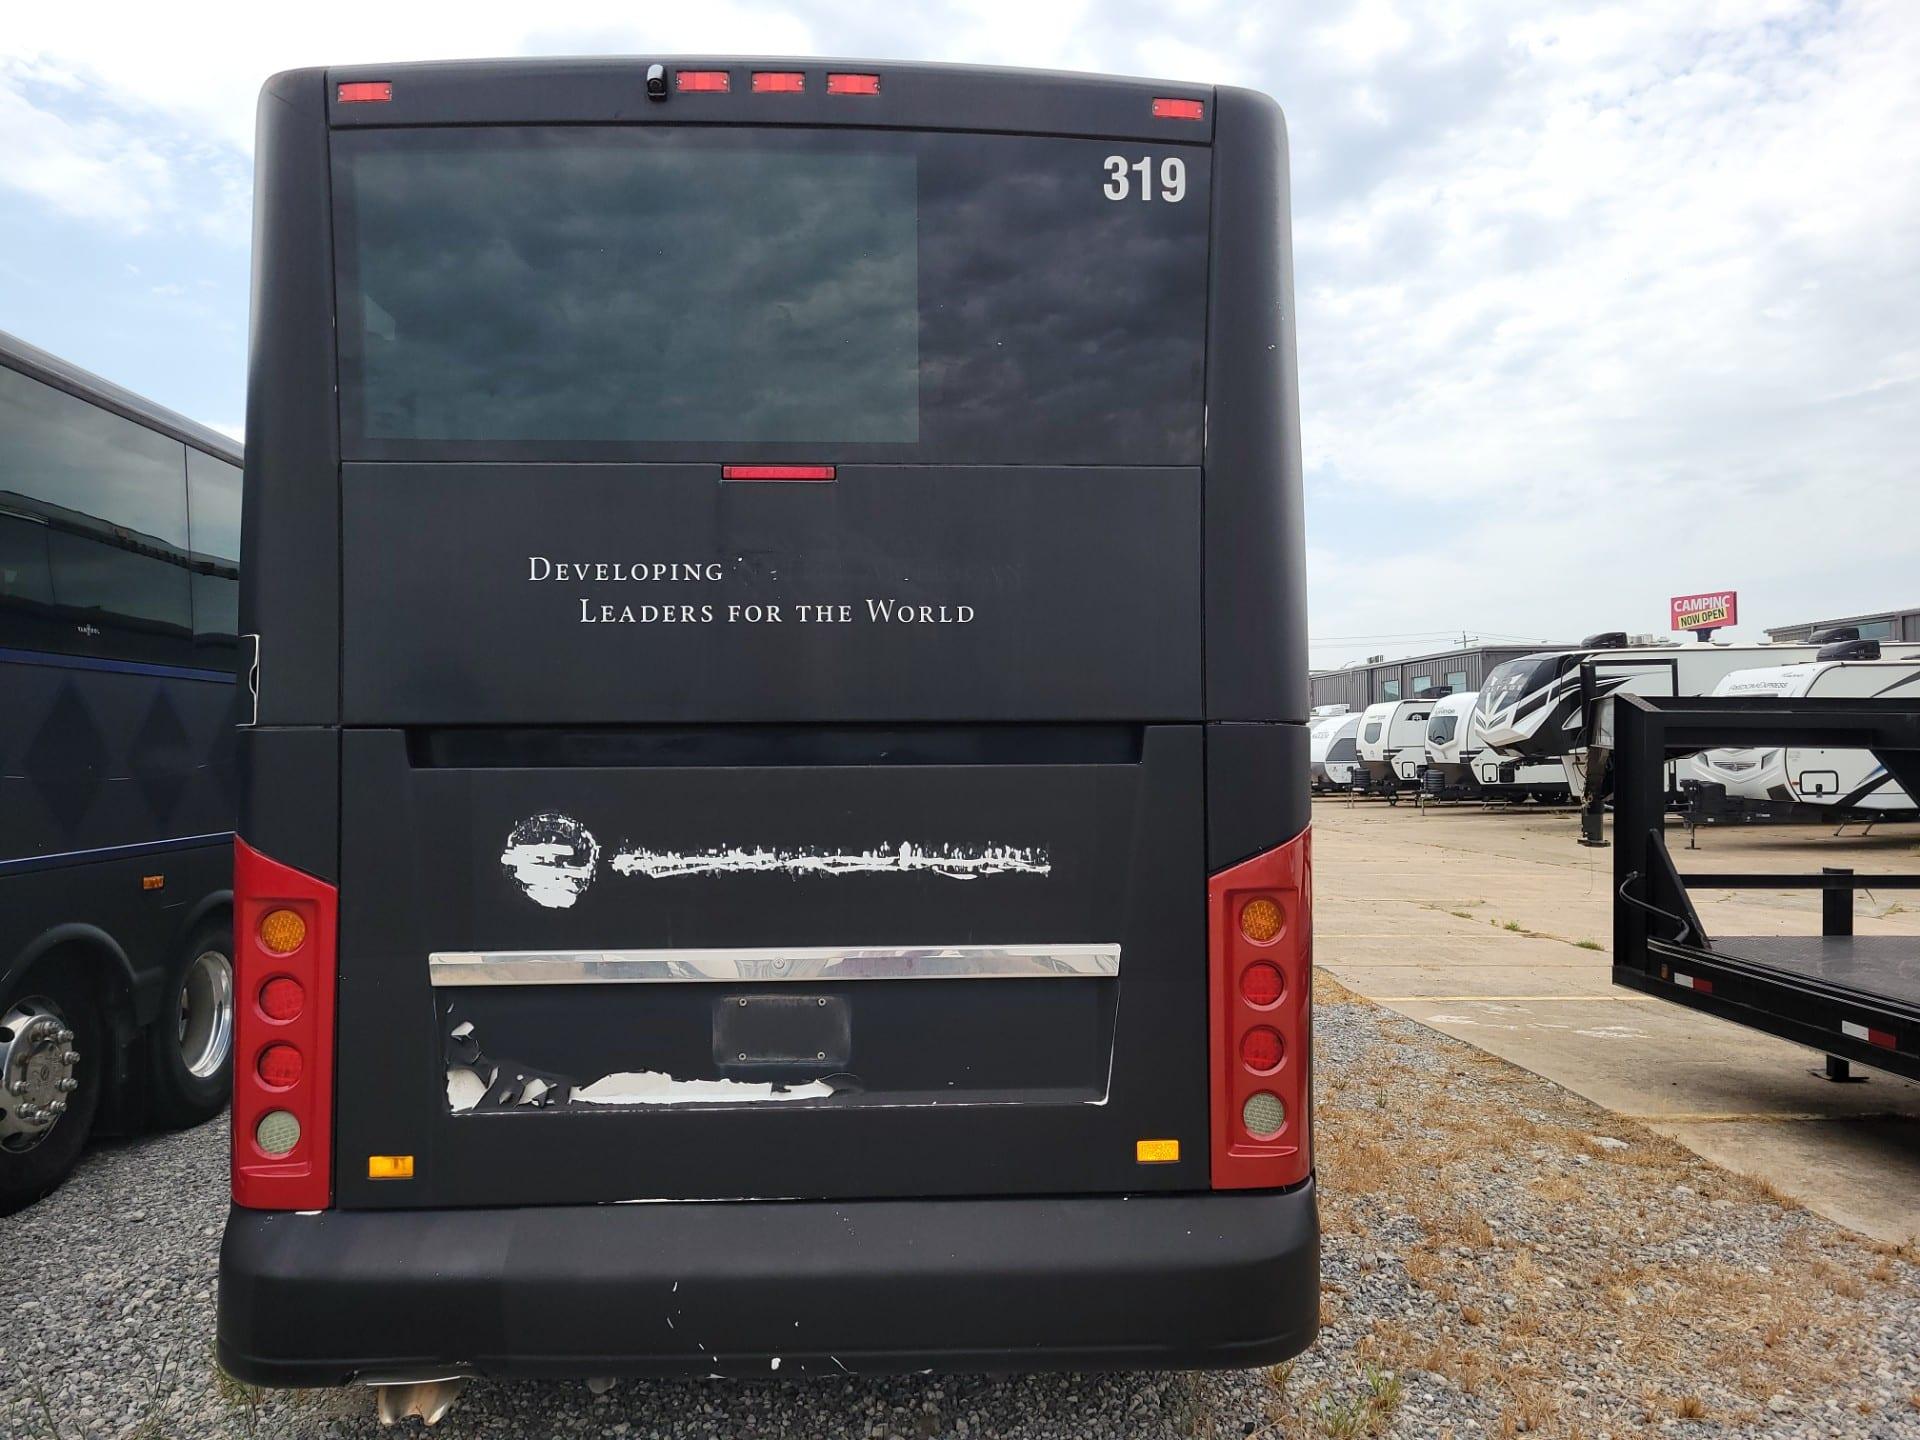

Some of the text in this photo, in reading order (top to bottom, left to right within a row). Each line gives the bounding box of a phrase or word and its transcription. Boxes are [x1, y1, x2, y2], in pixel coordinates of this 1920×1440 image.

[1103, 155, 1186, 203] 319
[528, 556, 723, 582] DEVELOPING
[579, 598, 975, 623] LEADERS FOR THE WORLD
[1681, 607, 1725, 627] NOW OPEN
